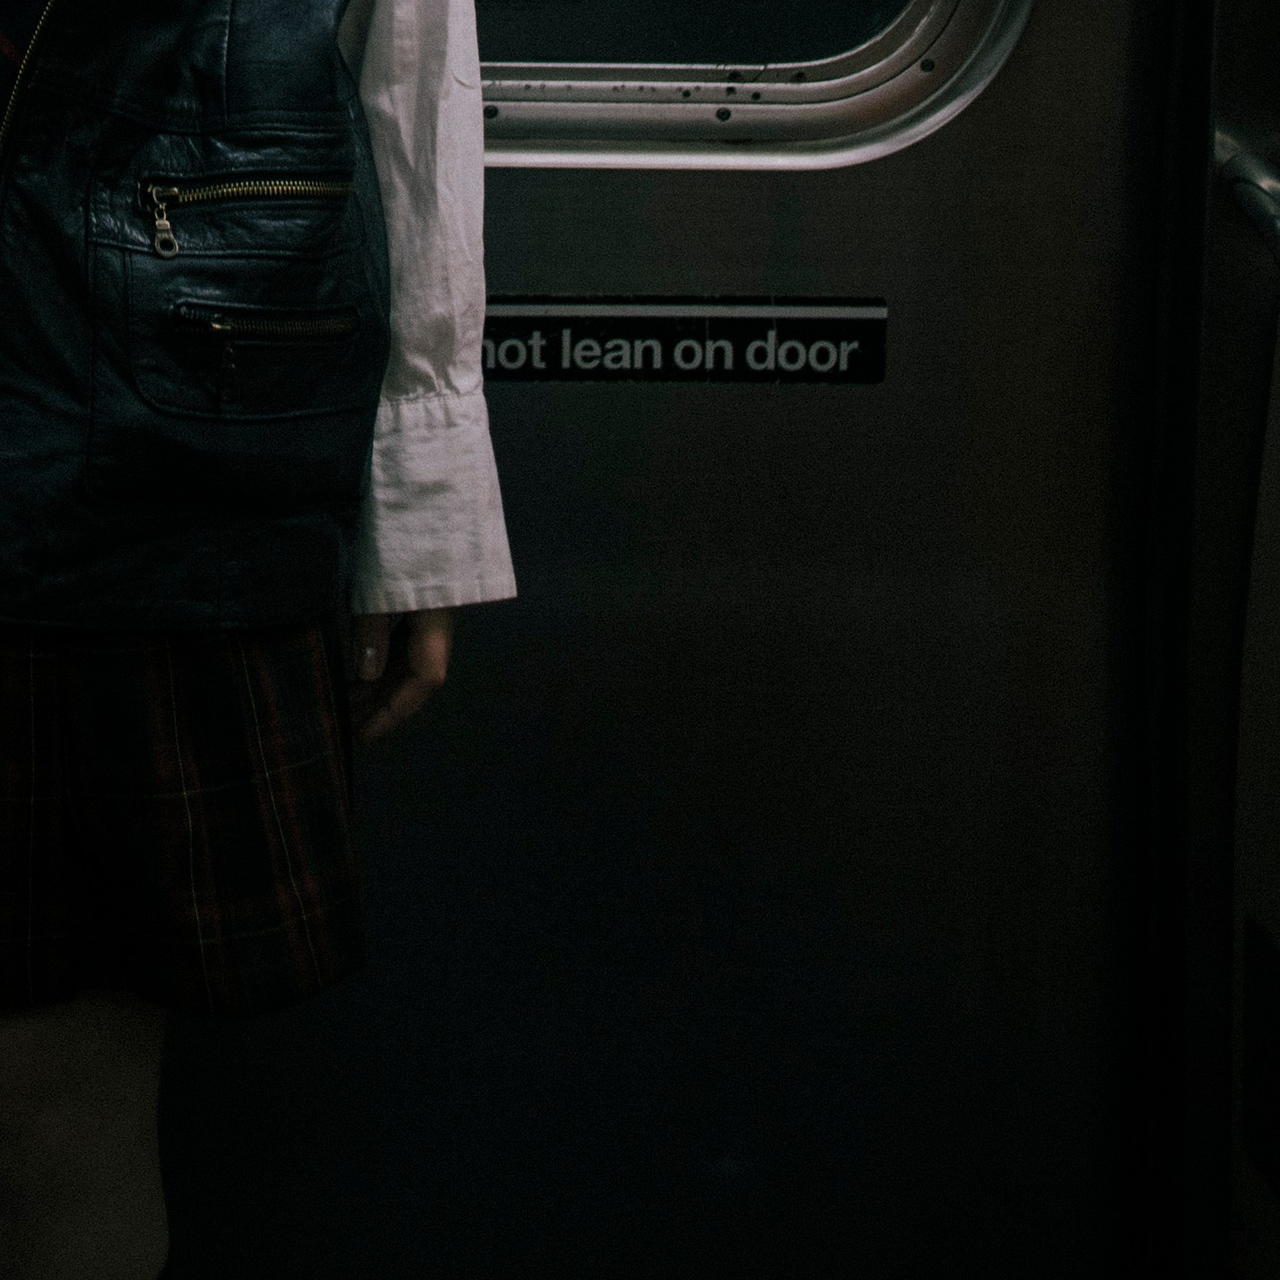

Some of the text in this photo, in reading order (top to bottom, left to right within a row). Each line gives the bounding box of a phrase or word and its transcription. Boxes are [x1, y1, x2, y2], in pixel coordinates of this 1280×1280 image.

[561, 327, 662, 370] lean
[673, 339, 734, 370] on
[745, 329, 860, 372] door
